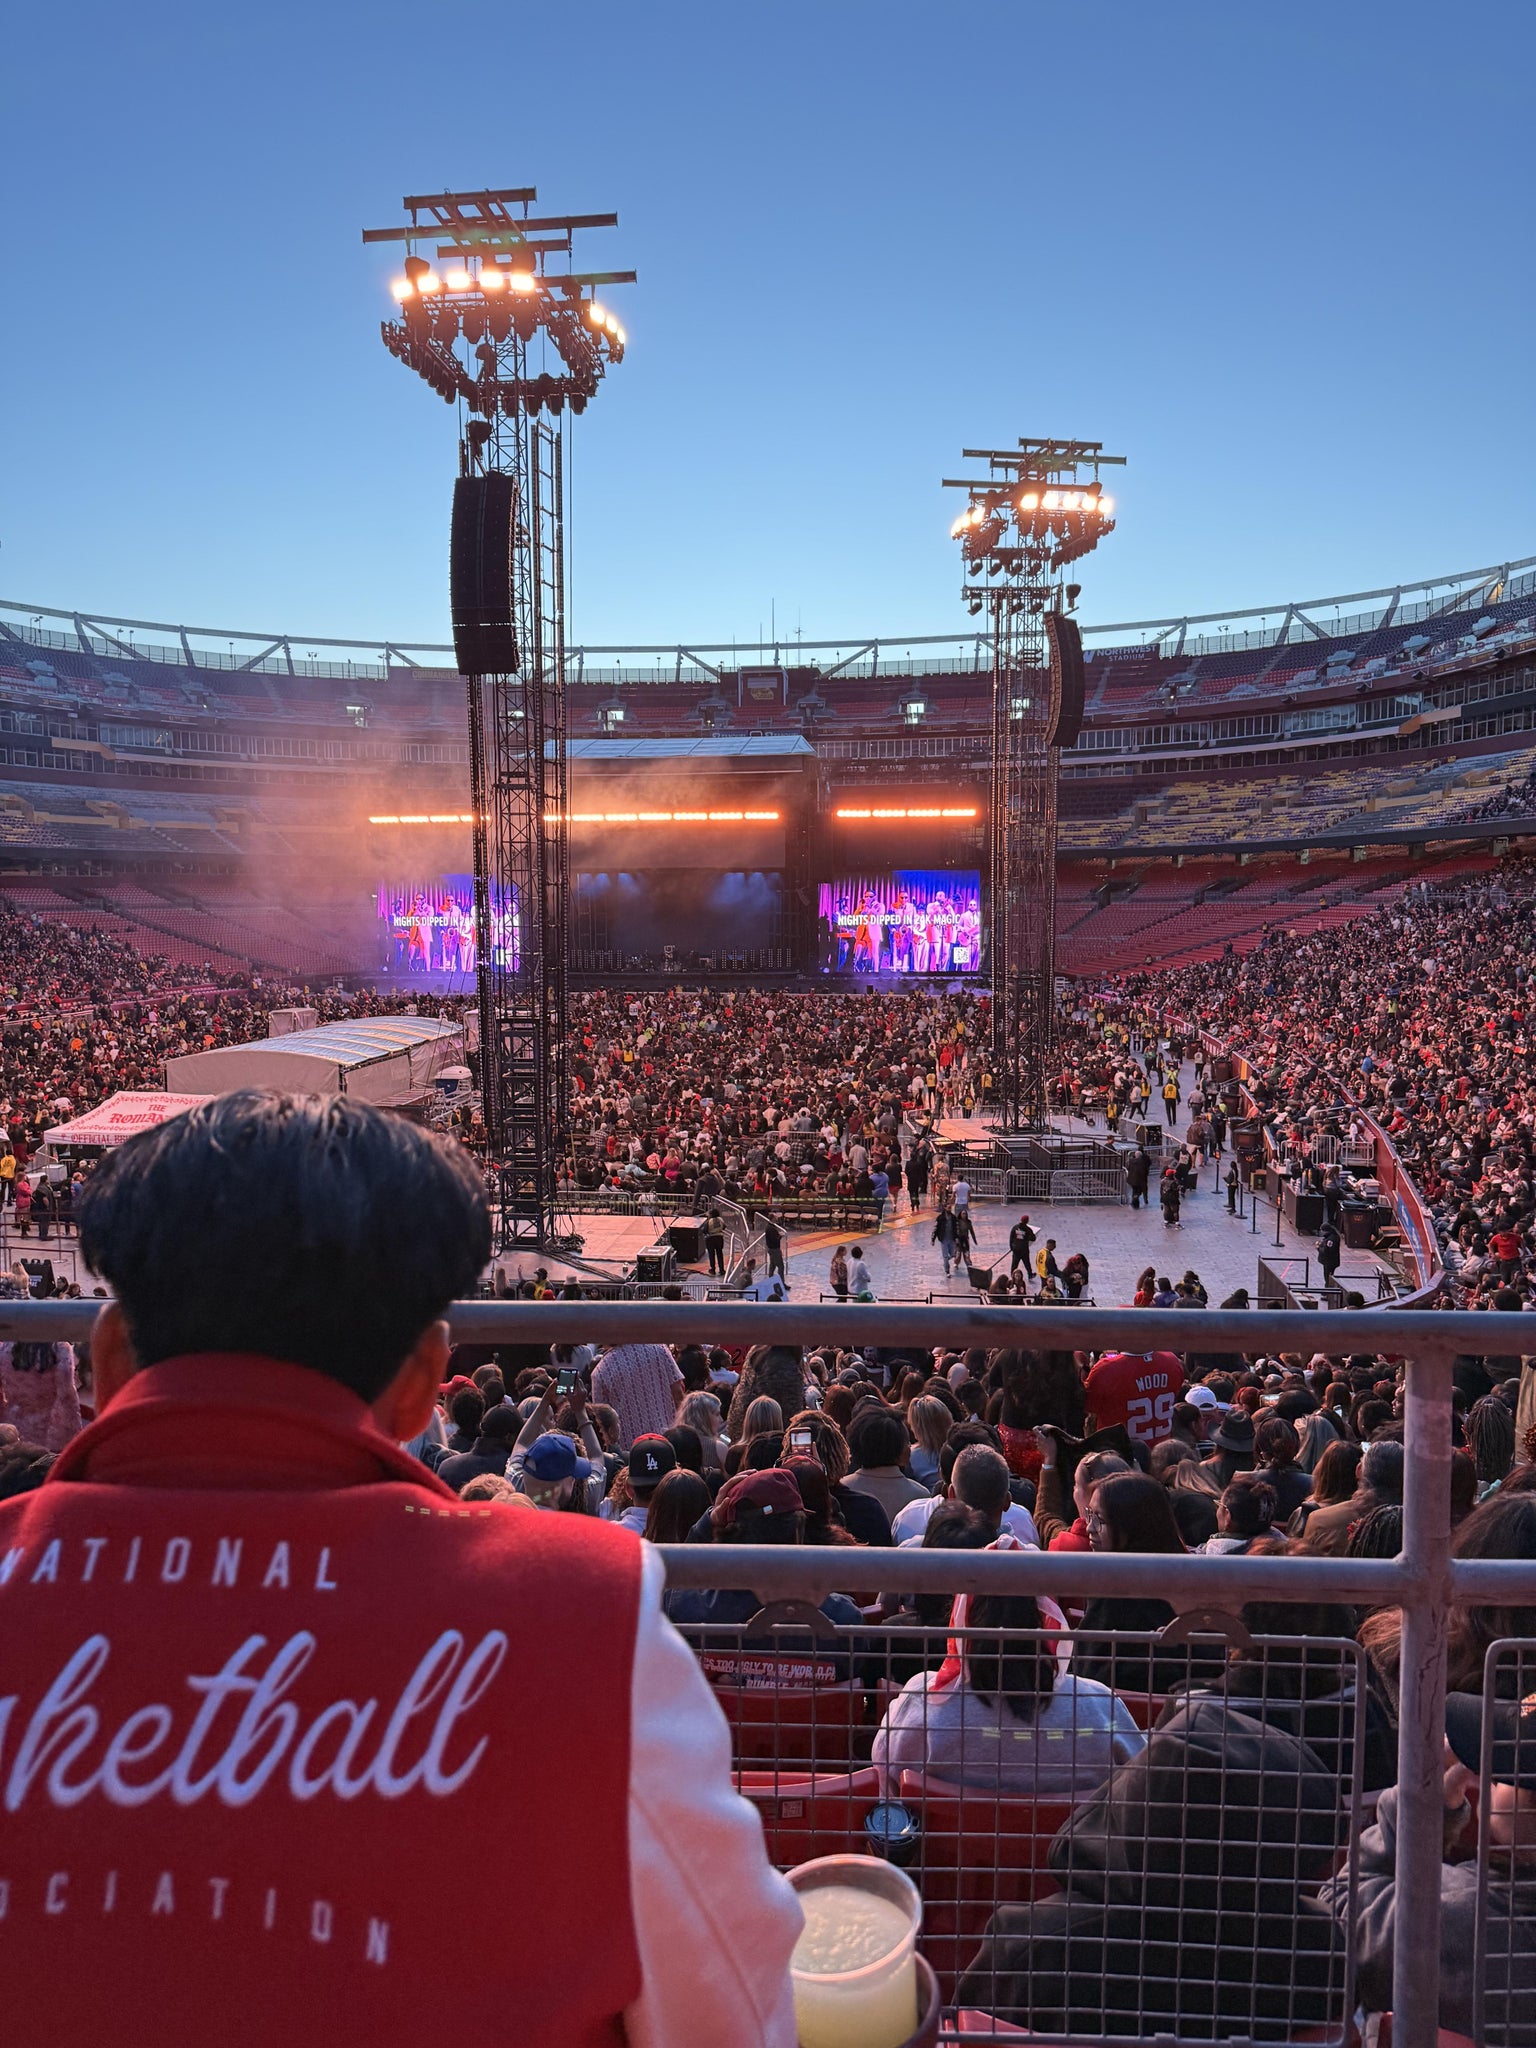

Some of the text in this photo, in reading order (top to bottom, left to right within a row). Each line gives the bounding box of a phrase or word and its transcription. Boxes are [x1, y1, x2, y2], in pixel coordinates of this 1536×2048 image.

[1097, 645, 1157, 656] NORTHWEST
[1109, 654, 1145, 662] STADIUM
[394, 916, 420, 926] NIGHTS
[422, 916, 448, 926] DIPPED
[838, 915, 868, 926] NIGHTS
[870, 915, 901, 925] DIPPED
[903, 915, 912, 925] IN
[933, 914, 960, 925] MAGIC
[148, 1104, 167, 1112] THE
[109, 1112, 169, 1124] ROMAN
[71, 1134, 112, 1144] OFFICIAL
[1136, 1373, 1169, 1392] WOOD
[1127, 1392, 1176, 1440] 29
[646, 1453, 659, 1470] LA
[762, 1662, 774, 1672] TO
[791, 1665, 823, 1677] WORD
